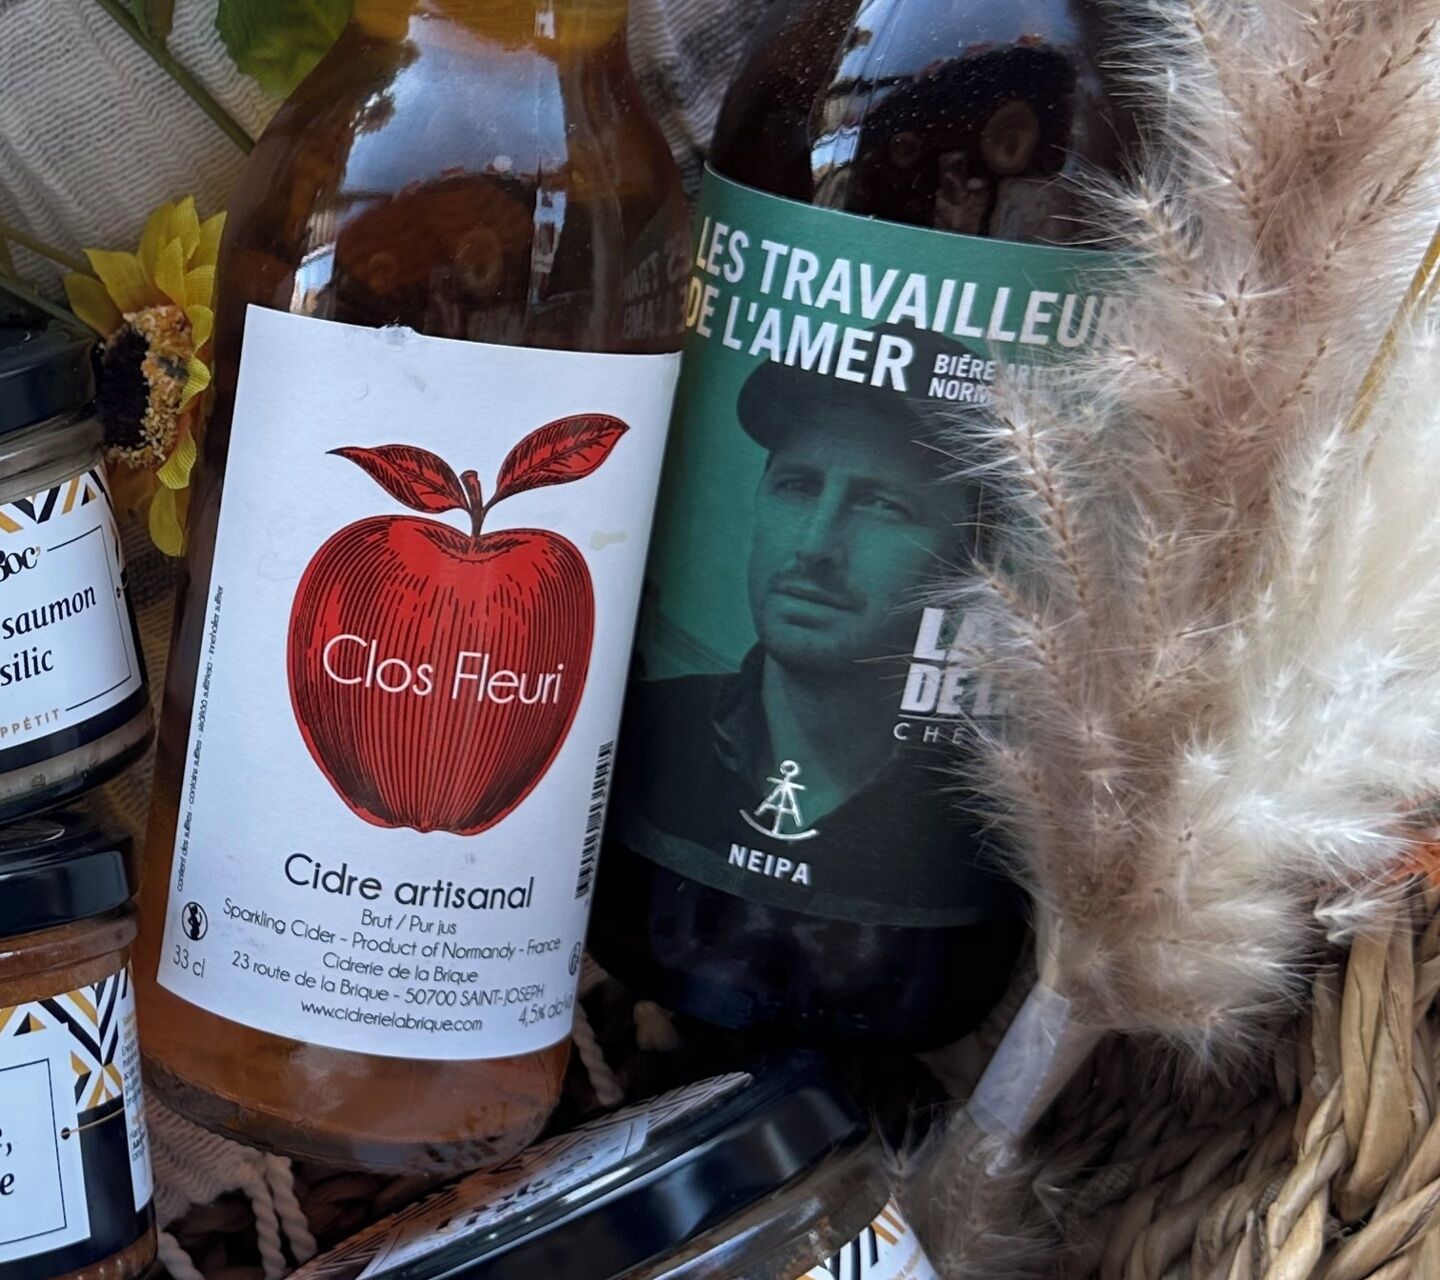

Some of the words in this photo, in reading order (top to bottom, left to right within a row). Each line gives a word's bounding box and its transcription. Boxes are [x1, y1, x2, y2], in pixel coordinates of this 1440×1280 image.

[696, 216, 749, 284] LES
[686, 275, 719, 338] DE
[722, 296, 914, 392] L'AMER
[2, 586, 96, 647] saumon
[322, 634, 433, 698] Clos
[452, 651, 563, 707] Fleuri
[285, 853, 382, 899] Cidre
[394, 876, 534, 910] artisanal
[728, 844, 811, 886] NEIPA
[223, 898, 286, 934] Sparkling
[291, 920, 335, 944] Cider
[352, 932, 416, 956] Product
[421, 942, 440, 957] of
[442, 941, 515, 961] Normandy
[527, 937, 561, 955] France
[361, 909, 393, 929] Brut
[410, 915, 435, 934] Pur
[436, 920, 457, 935] jus
[173, 944, 189, 970] 33
[193, 958, 205, 978] cl
[232, 950, 249, 970] 23
[253, 961, 290, 981] route
[295, 971, 316, 988] de
[321, 976, 335, 993] la
[340, 979, 389, 1005] Brique
[405, 988, 457, 1006] 50700
[460, 983, 544, 1007] SAINT-JOSEPH
[322, 951, 384, 976] Cidrerie
[388, 964, 410, 979] de
[415, 965, 429, 980] la
[434, 966, 479, 984] Brique
[300, 1000, 483, 1033] www.cidrerielabrique.com
